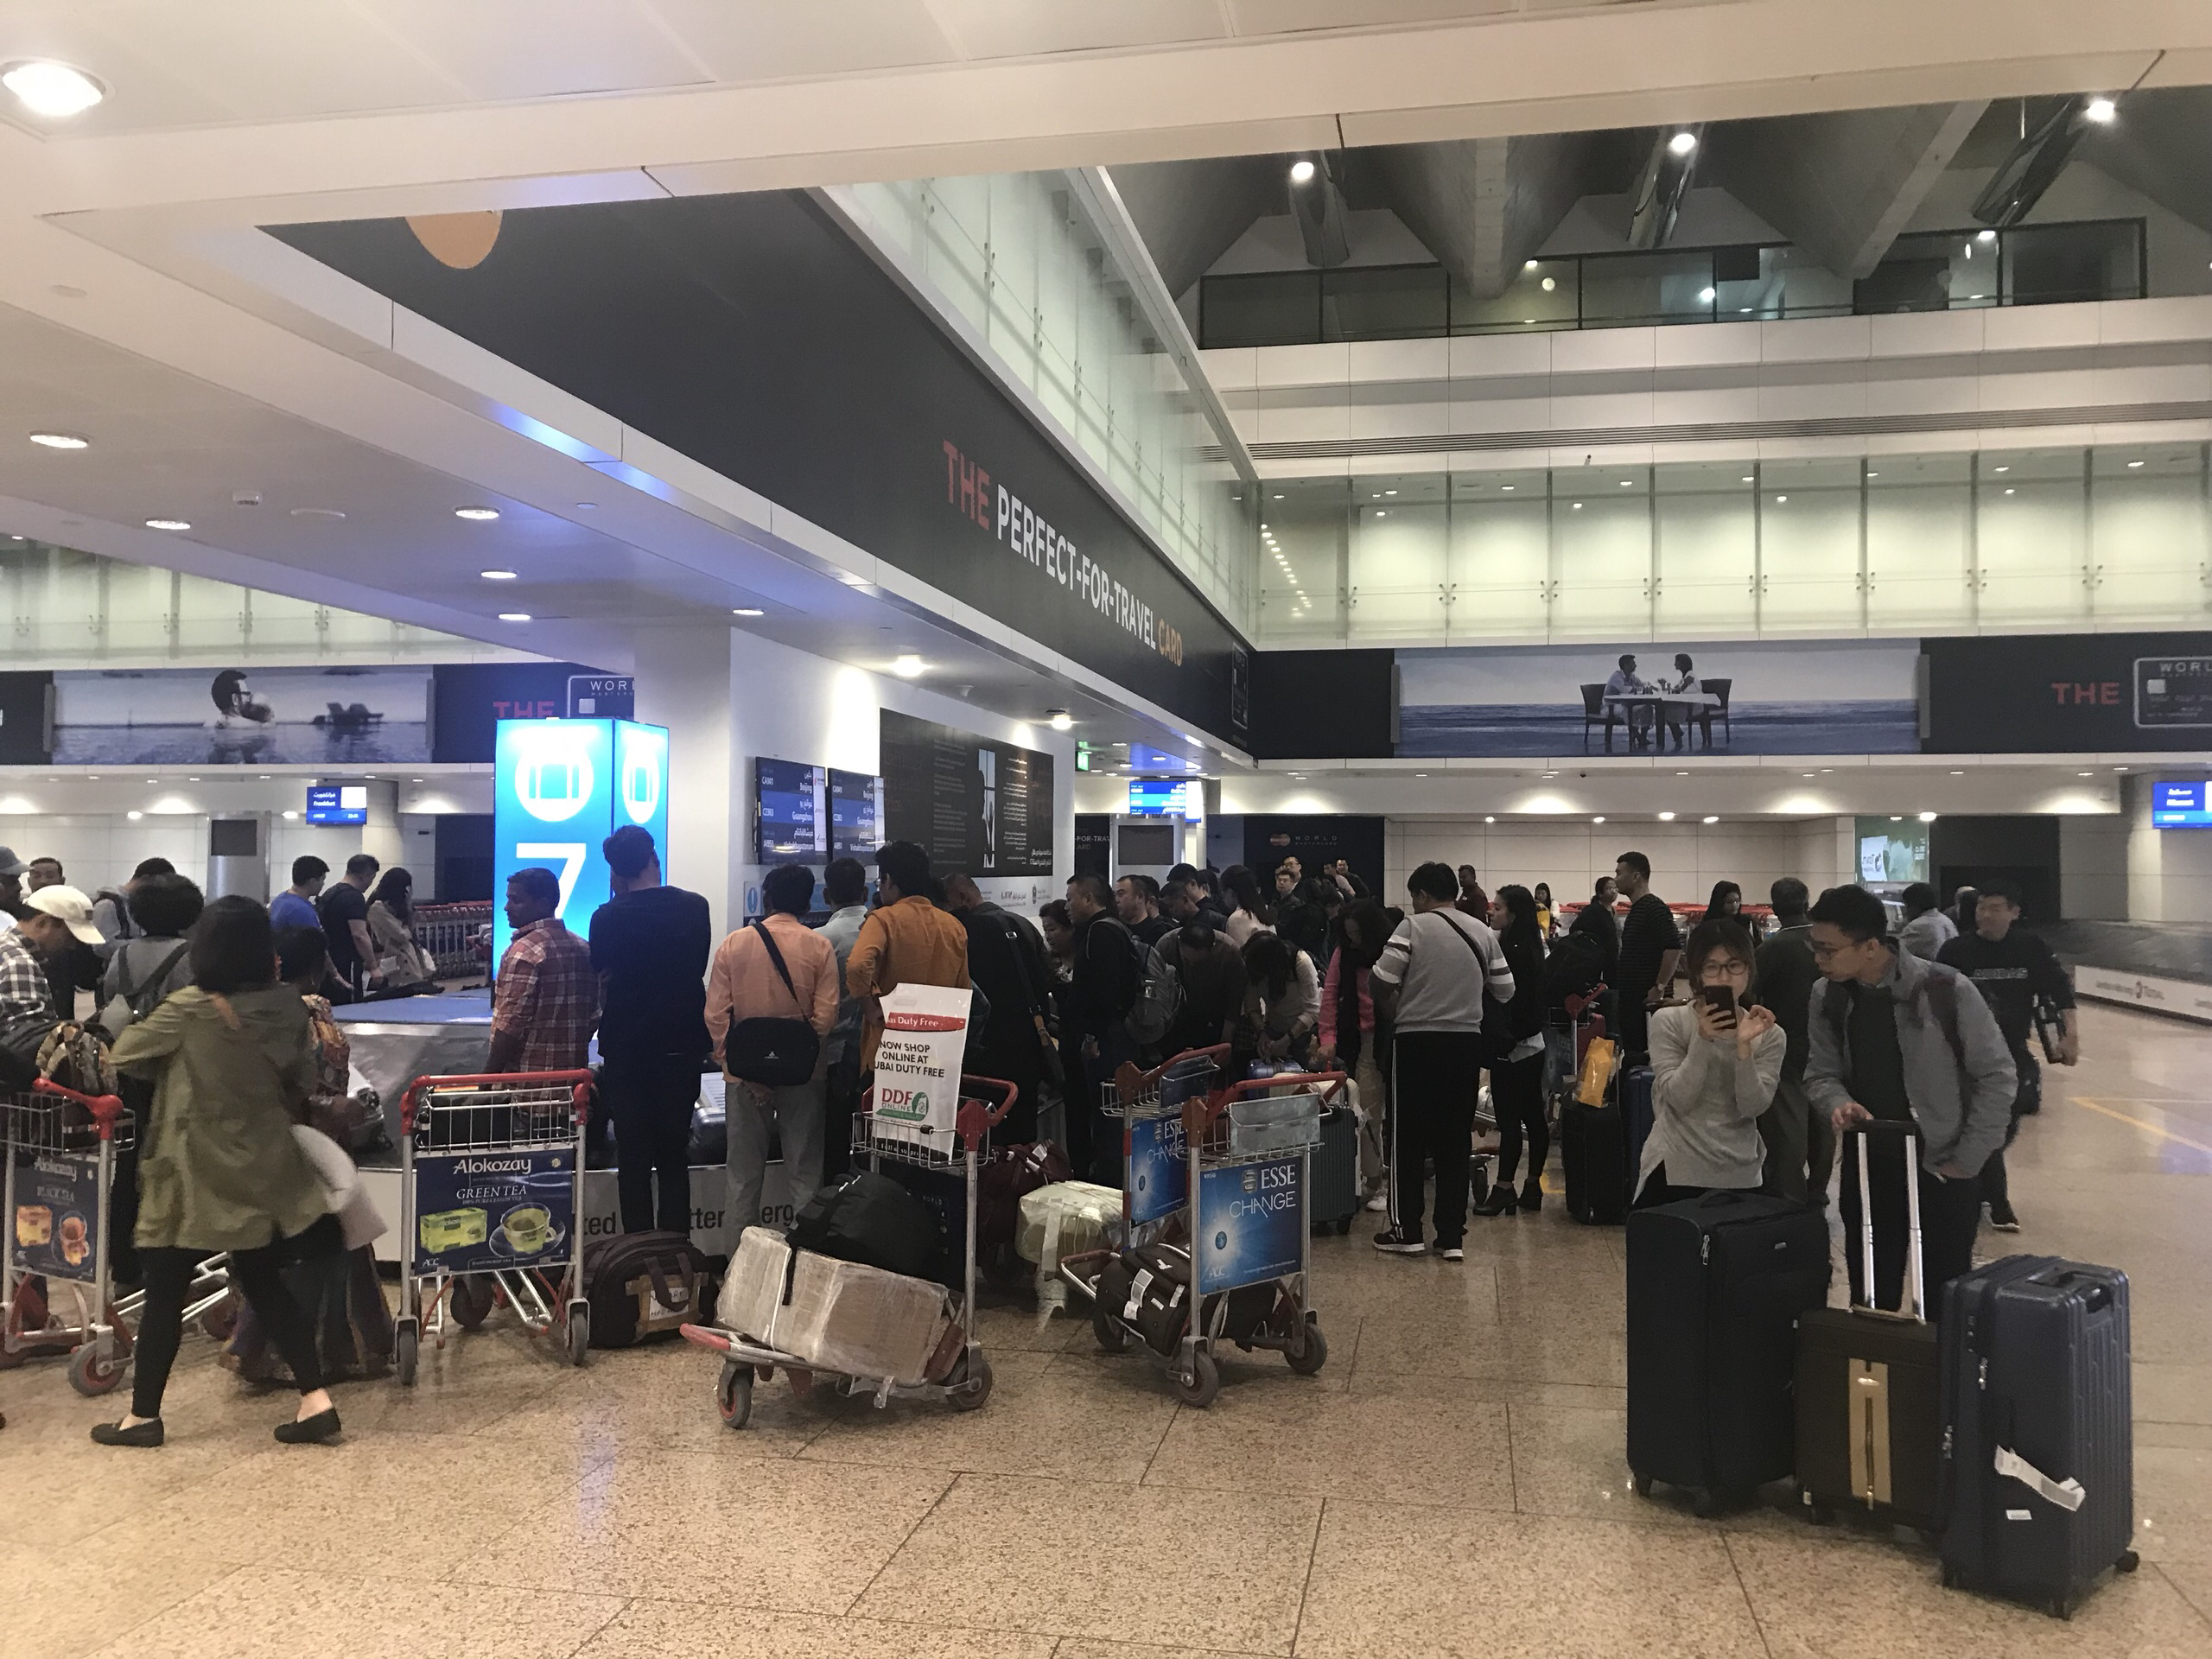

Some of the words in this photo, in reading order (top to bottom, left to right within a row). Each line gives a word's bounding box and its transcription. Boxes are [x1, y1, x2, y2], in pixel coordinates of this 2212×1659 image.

[944, 439, 990, 531] THE
[997, 483, 1156, 650] PERFECT-FOR-TRAVEL
[1158, 618, 1183, 667] CARD
[590, 680, 635, 690] WOR
[2051, 682, 2120, 705] THE
[493, 701, 556, 718] THE
[516, 842, 587, 919] 7
[898, 1016, 918, 1027] Duty
[919, 1017, 939, 1027] Free
[880, 1040, 902, 1051] NOW
[904, 1042, 931, 1053] SHOP
[881, 1051, 916, 1063] ONLINE
[917, 1055, 929, 1065] AT
[895, 1063, 922, 1075] DUTY
[923, 1066, 945, 1077] FREE
[881, 1087, 913, 1105] DDF
[881, 1102, 912, 1112] ONLINE
[452, 1158, 532, 1175] Alokozay
[1261, 1164, 1296, 1190] ESSE
[456, 1186, 501, 1200] GREEN
[503, 1185, 527, 1196] TEA
[1229, 1191, 1296, 1218] CHANGE
